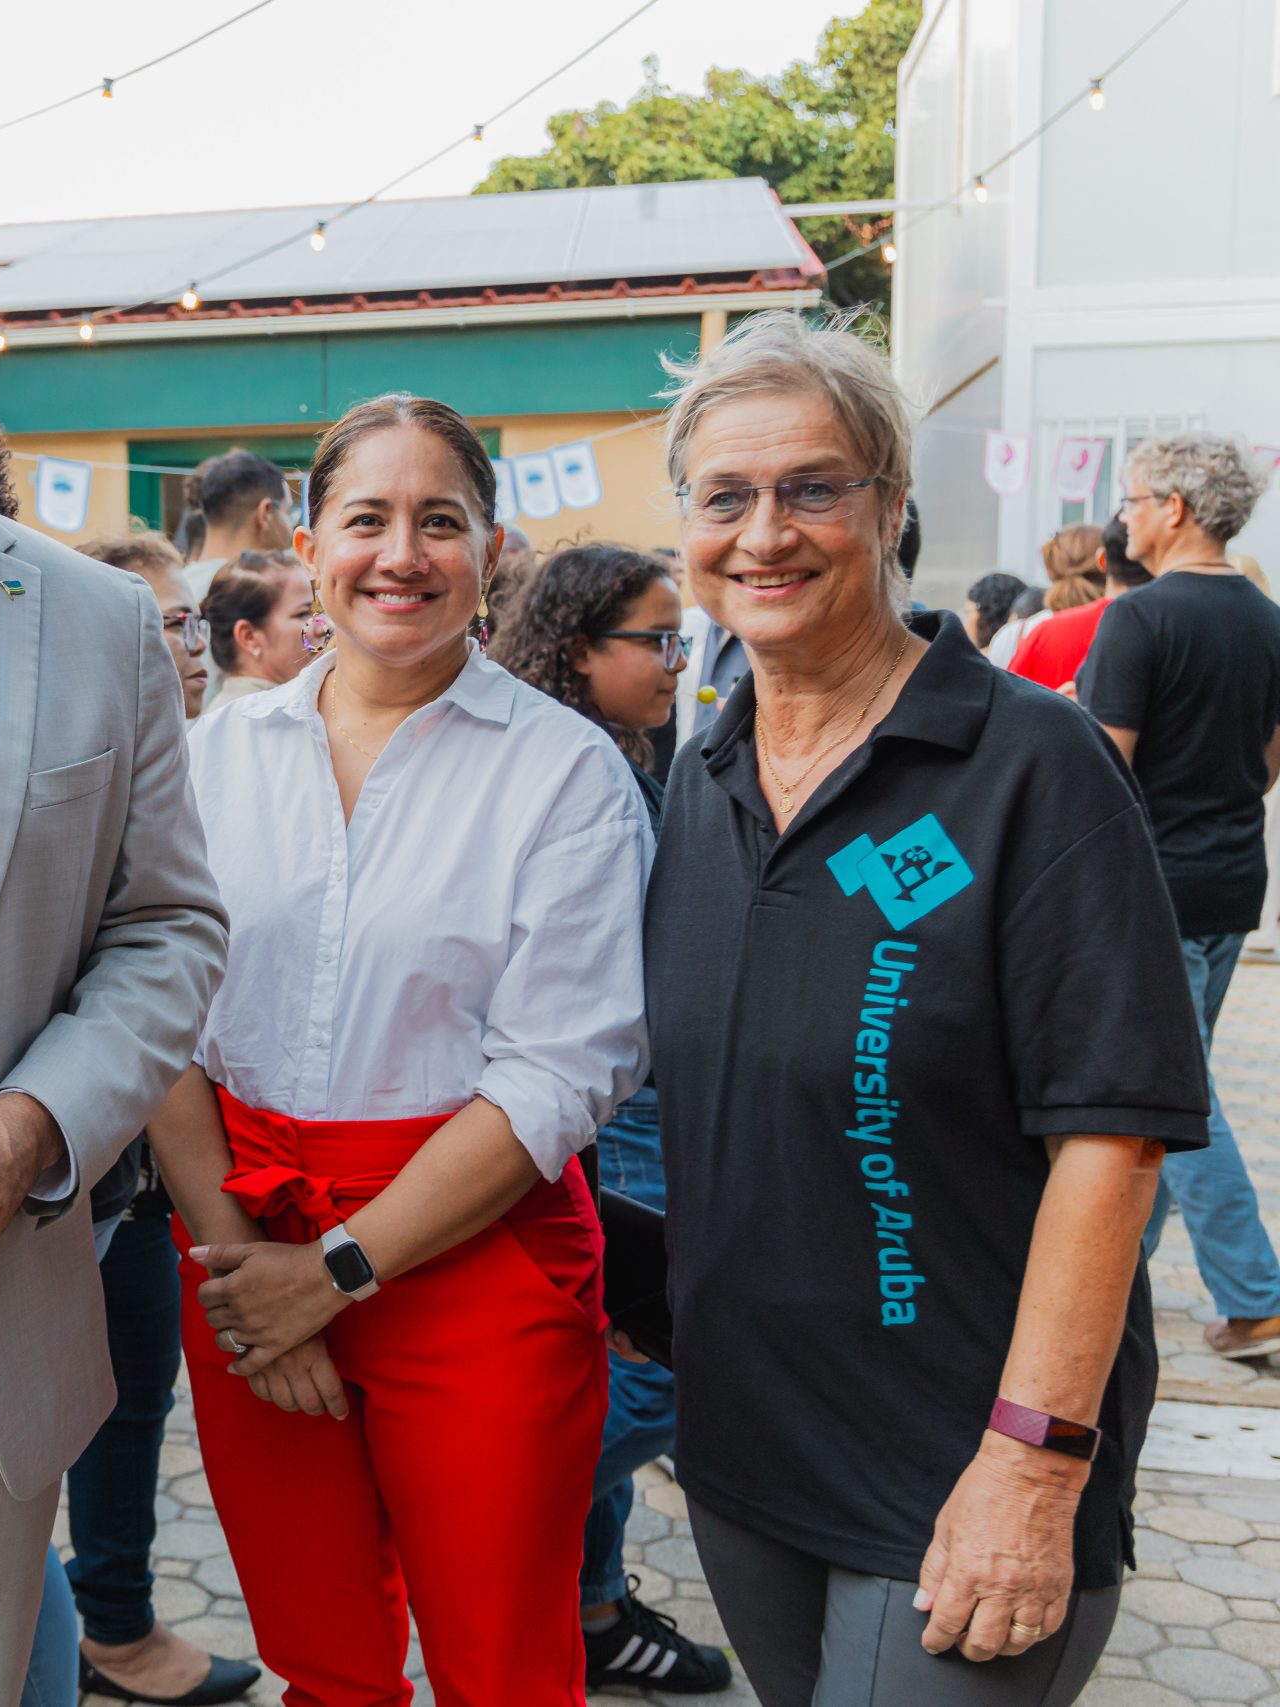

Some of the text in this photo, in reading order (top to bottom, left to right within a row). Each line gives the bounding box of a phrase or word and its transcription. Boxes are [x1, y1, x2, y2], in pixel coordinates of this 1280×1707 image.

[846, 939, 925, 1327] University of Aruba
